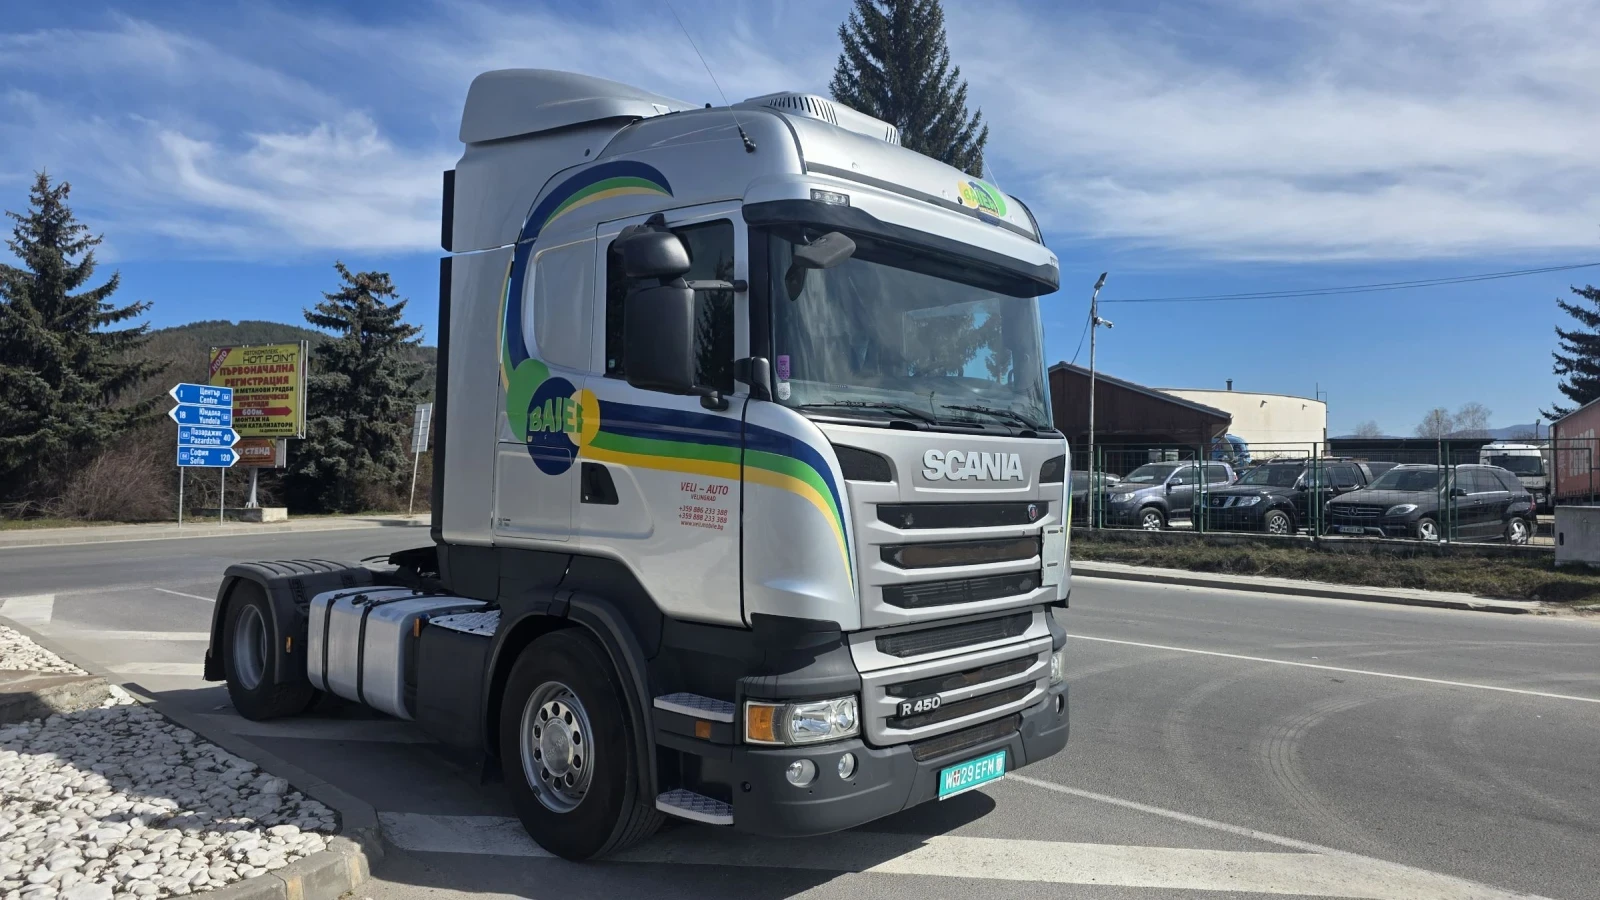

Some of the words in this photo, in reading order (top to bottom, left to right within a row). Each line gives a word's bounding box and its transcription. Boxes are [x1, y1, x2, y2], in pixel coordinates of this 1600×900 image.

[212, 350, 227, 371] НОВО
[242, 355, 264, 364] HOT
[265, 353, 296, 363] POINT
[219, 364, 295, 376] ПЪРВОНАЧАЛНА
[225, 376, 289, 387] РЕГИСТРАЦИЯ
[200, 386, 220, 398] Център
[200, 396, 218, 404] Centre
[199, 408, 220, 416] Юндола
[199, 416, 220, 424] Yundola
[191, 428, 222, 437] Пазарджик
[190, 436, 220, 445] Pazardzhik
[190, 448, 209, 456] София
[244, 446, 270, 456] СТЕНД
[220, 454, 230, 462] 120
[922, 449, 1024, 481] SCANIA
[680, 482, 697, 492] VELI
[706, 484, 729, 495] AUTO
[902, 703, 912, 716] R
[914, 696, 940, 712] 450
